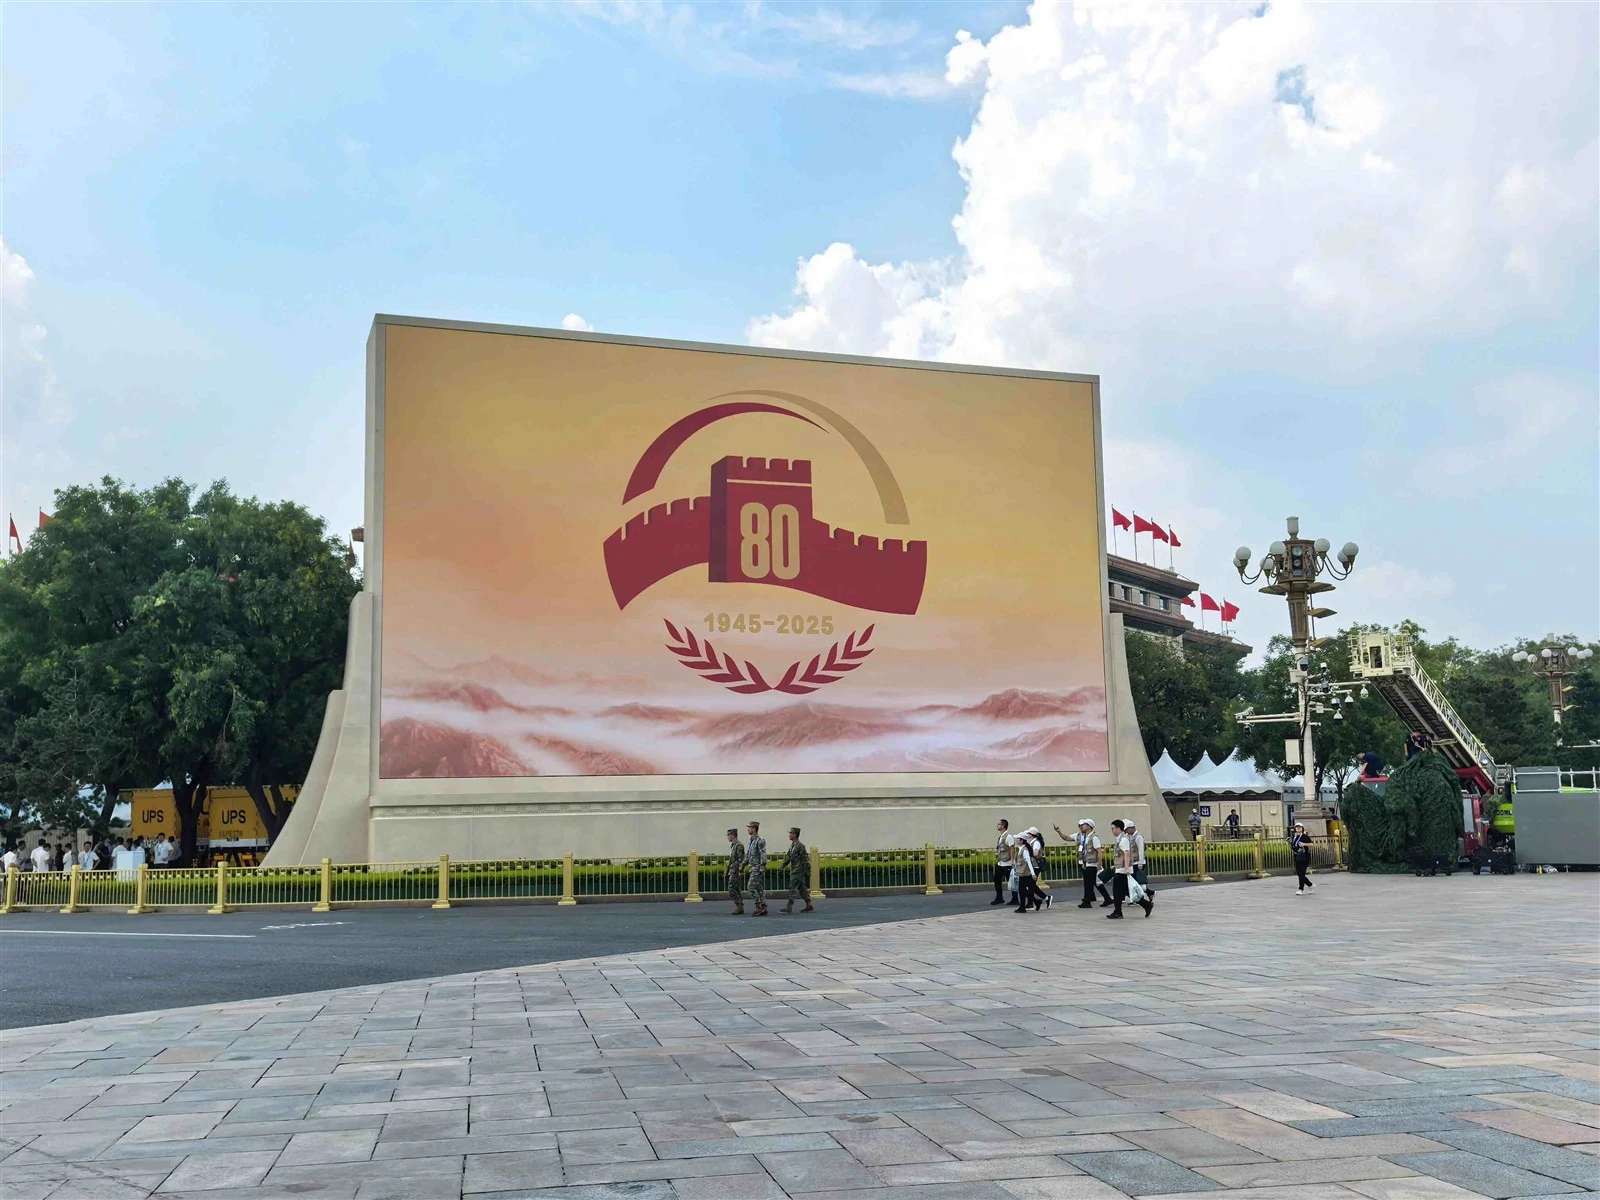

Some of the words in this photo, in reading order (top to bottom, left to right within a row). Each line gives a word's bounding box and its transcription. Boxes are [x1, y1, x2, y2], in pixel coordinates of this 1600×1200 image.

[740, 502, 800, 580] 80
[704, 612, 834, 635] 1945-2025
[142, 809, 164, 824] UPS
[221, 809, 246, 825] UPS
